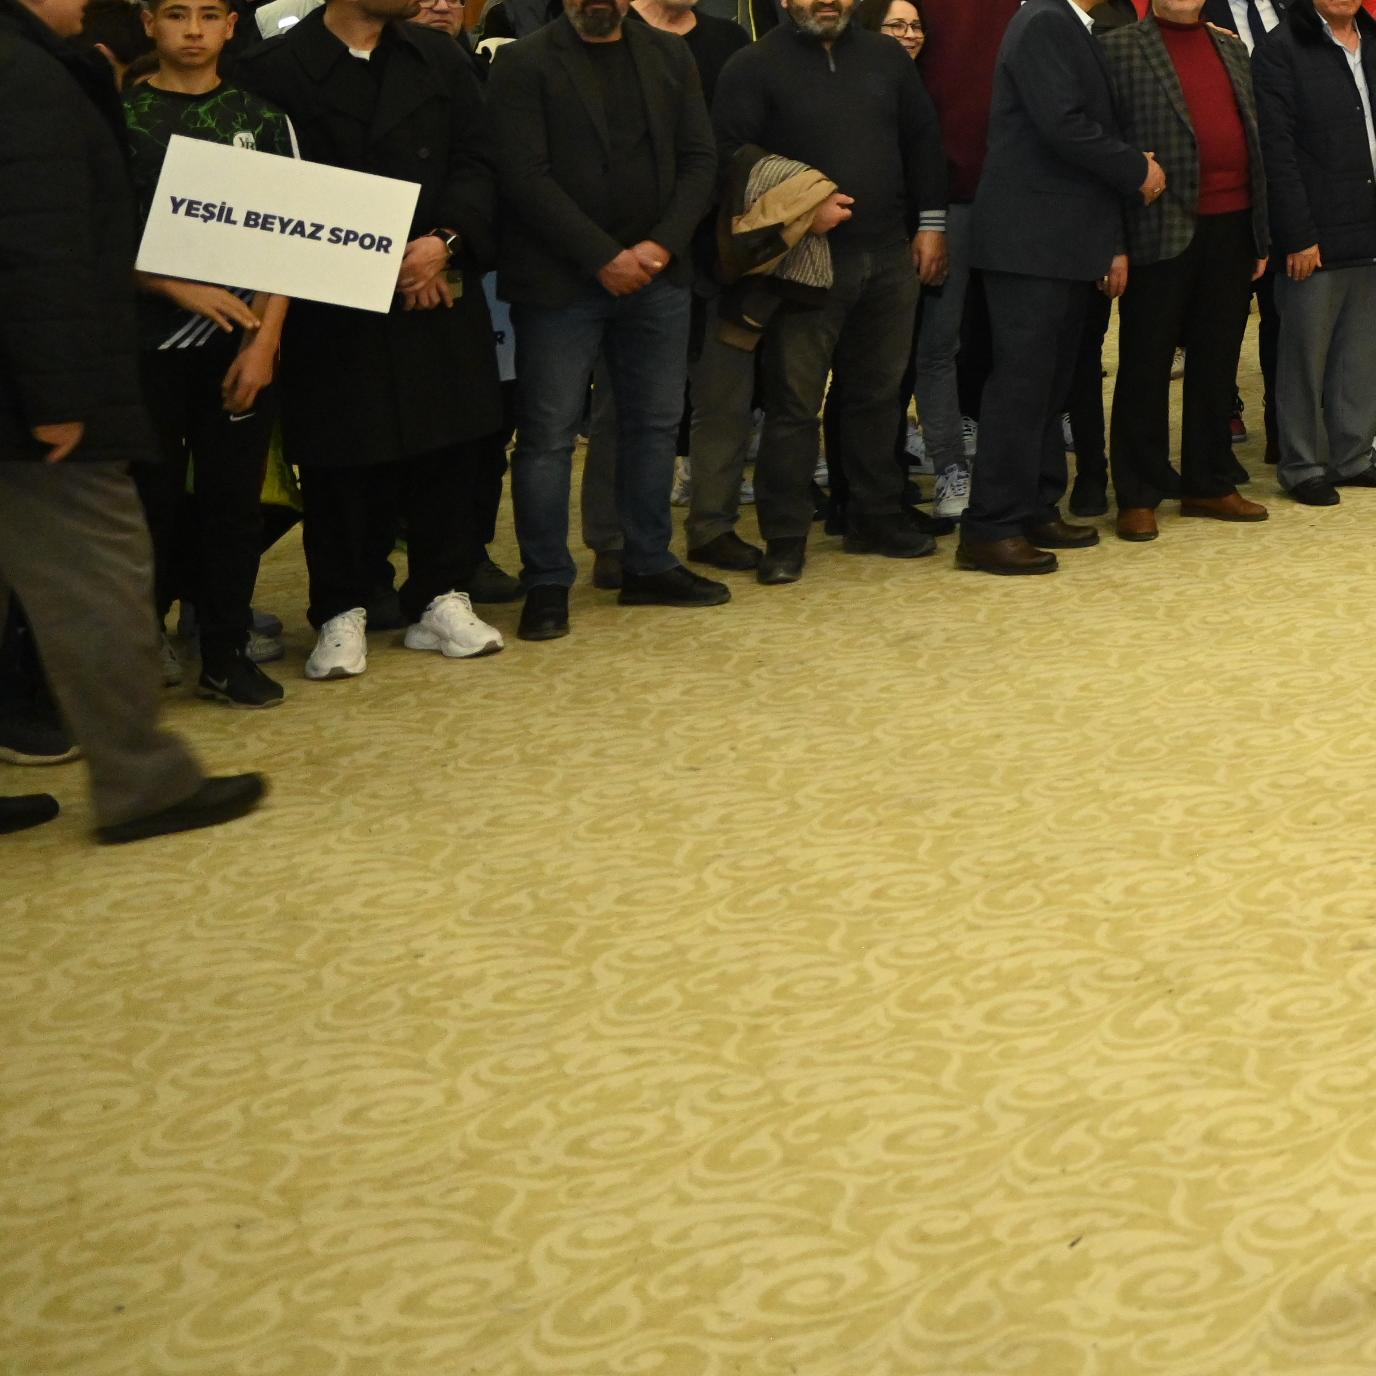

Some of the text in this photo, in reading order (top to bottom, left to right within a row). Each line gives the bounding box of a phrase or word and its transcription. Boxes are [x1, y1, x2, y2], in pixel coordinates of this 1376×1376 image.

[169, 195, 393, 254] YEŞİL BEYAZ SPOR
